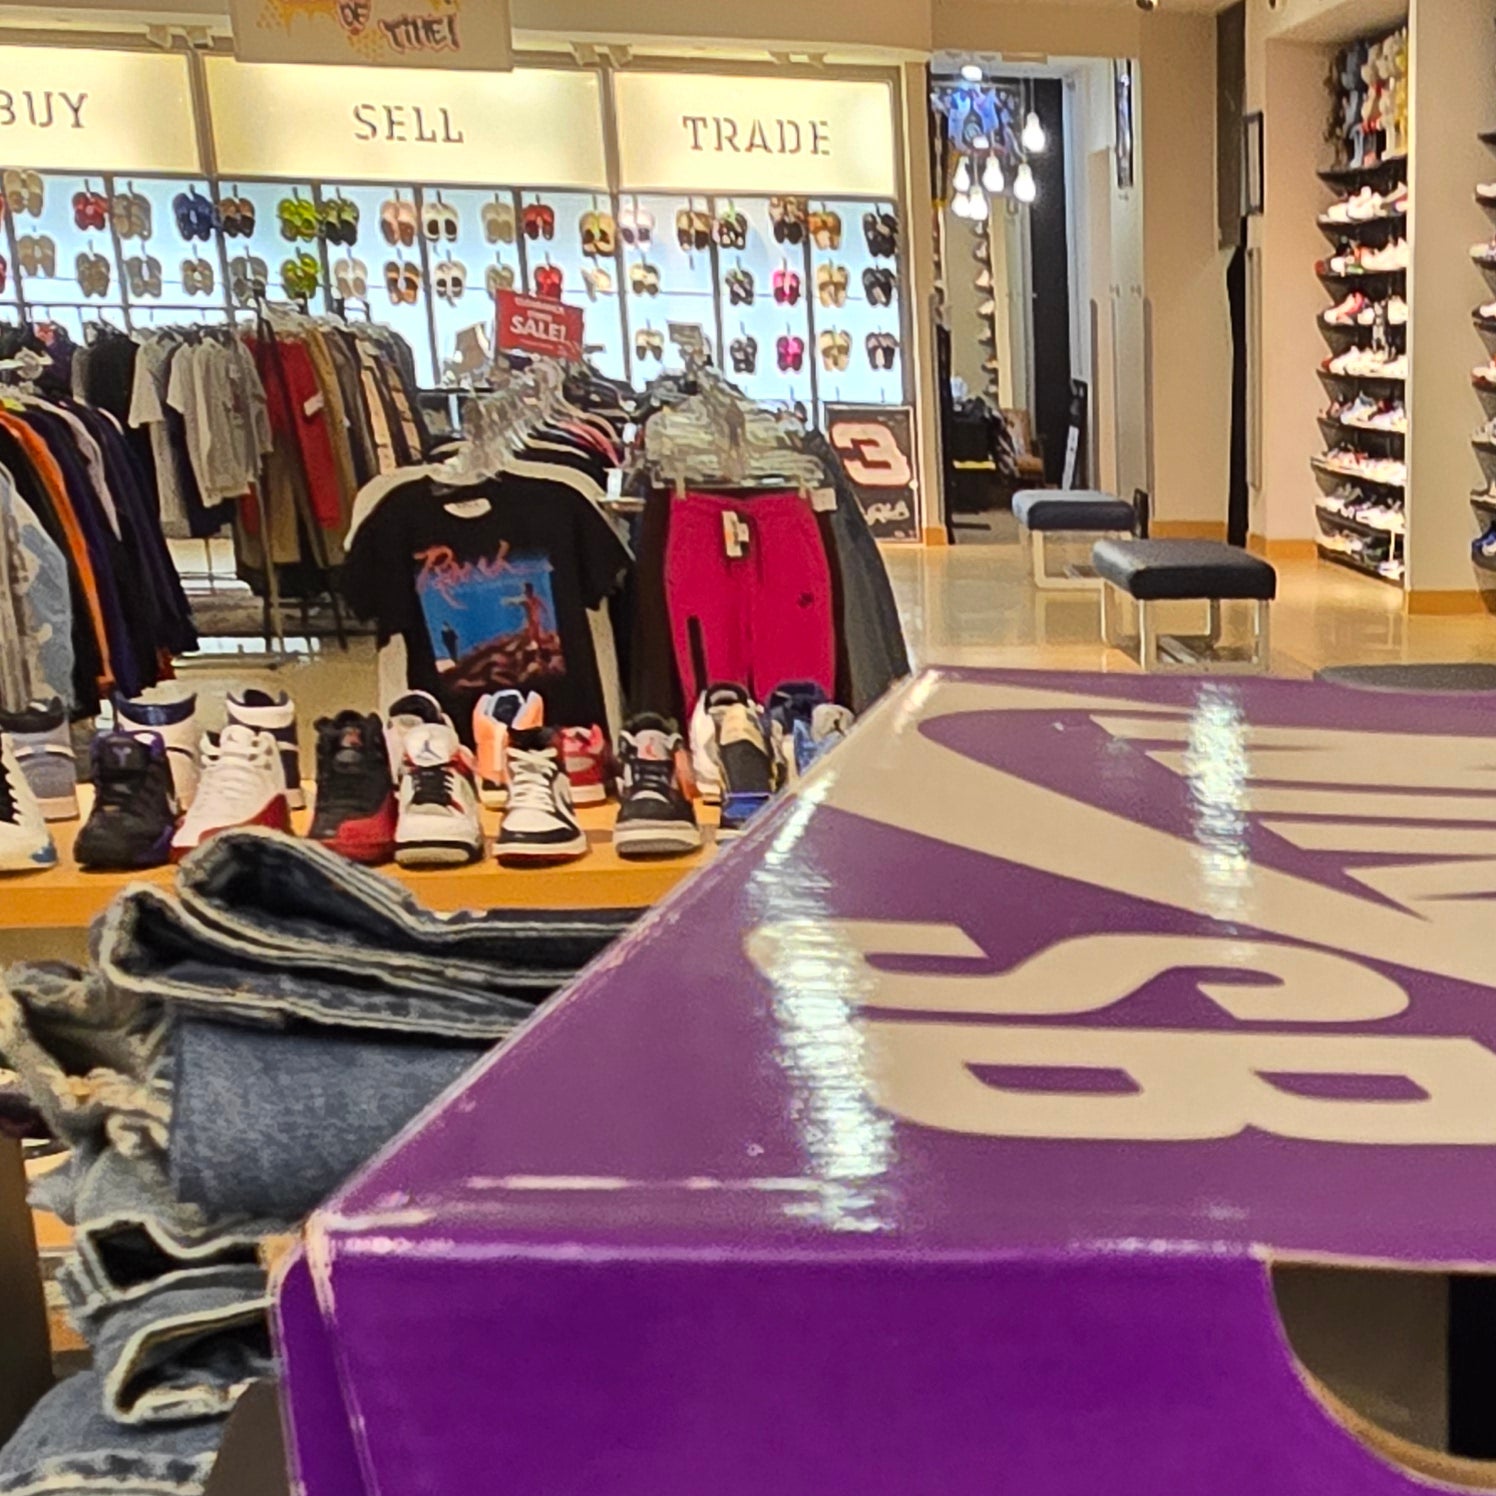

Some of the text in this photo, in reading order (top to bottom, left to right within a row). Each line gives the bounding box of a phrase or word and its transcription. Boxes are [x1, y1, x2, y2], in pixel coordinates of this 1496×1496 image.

[0, 90, 89, 129] BUY
[353, 104, 465, 144] SELL
[681, 115, 832, 156] TRADE
[509, 314, 567, 342] SALE!
[831, 422, 911, 486] 3
